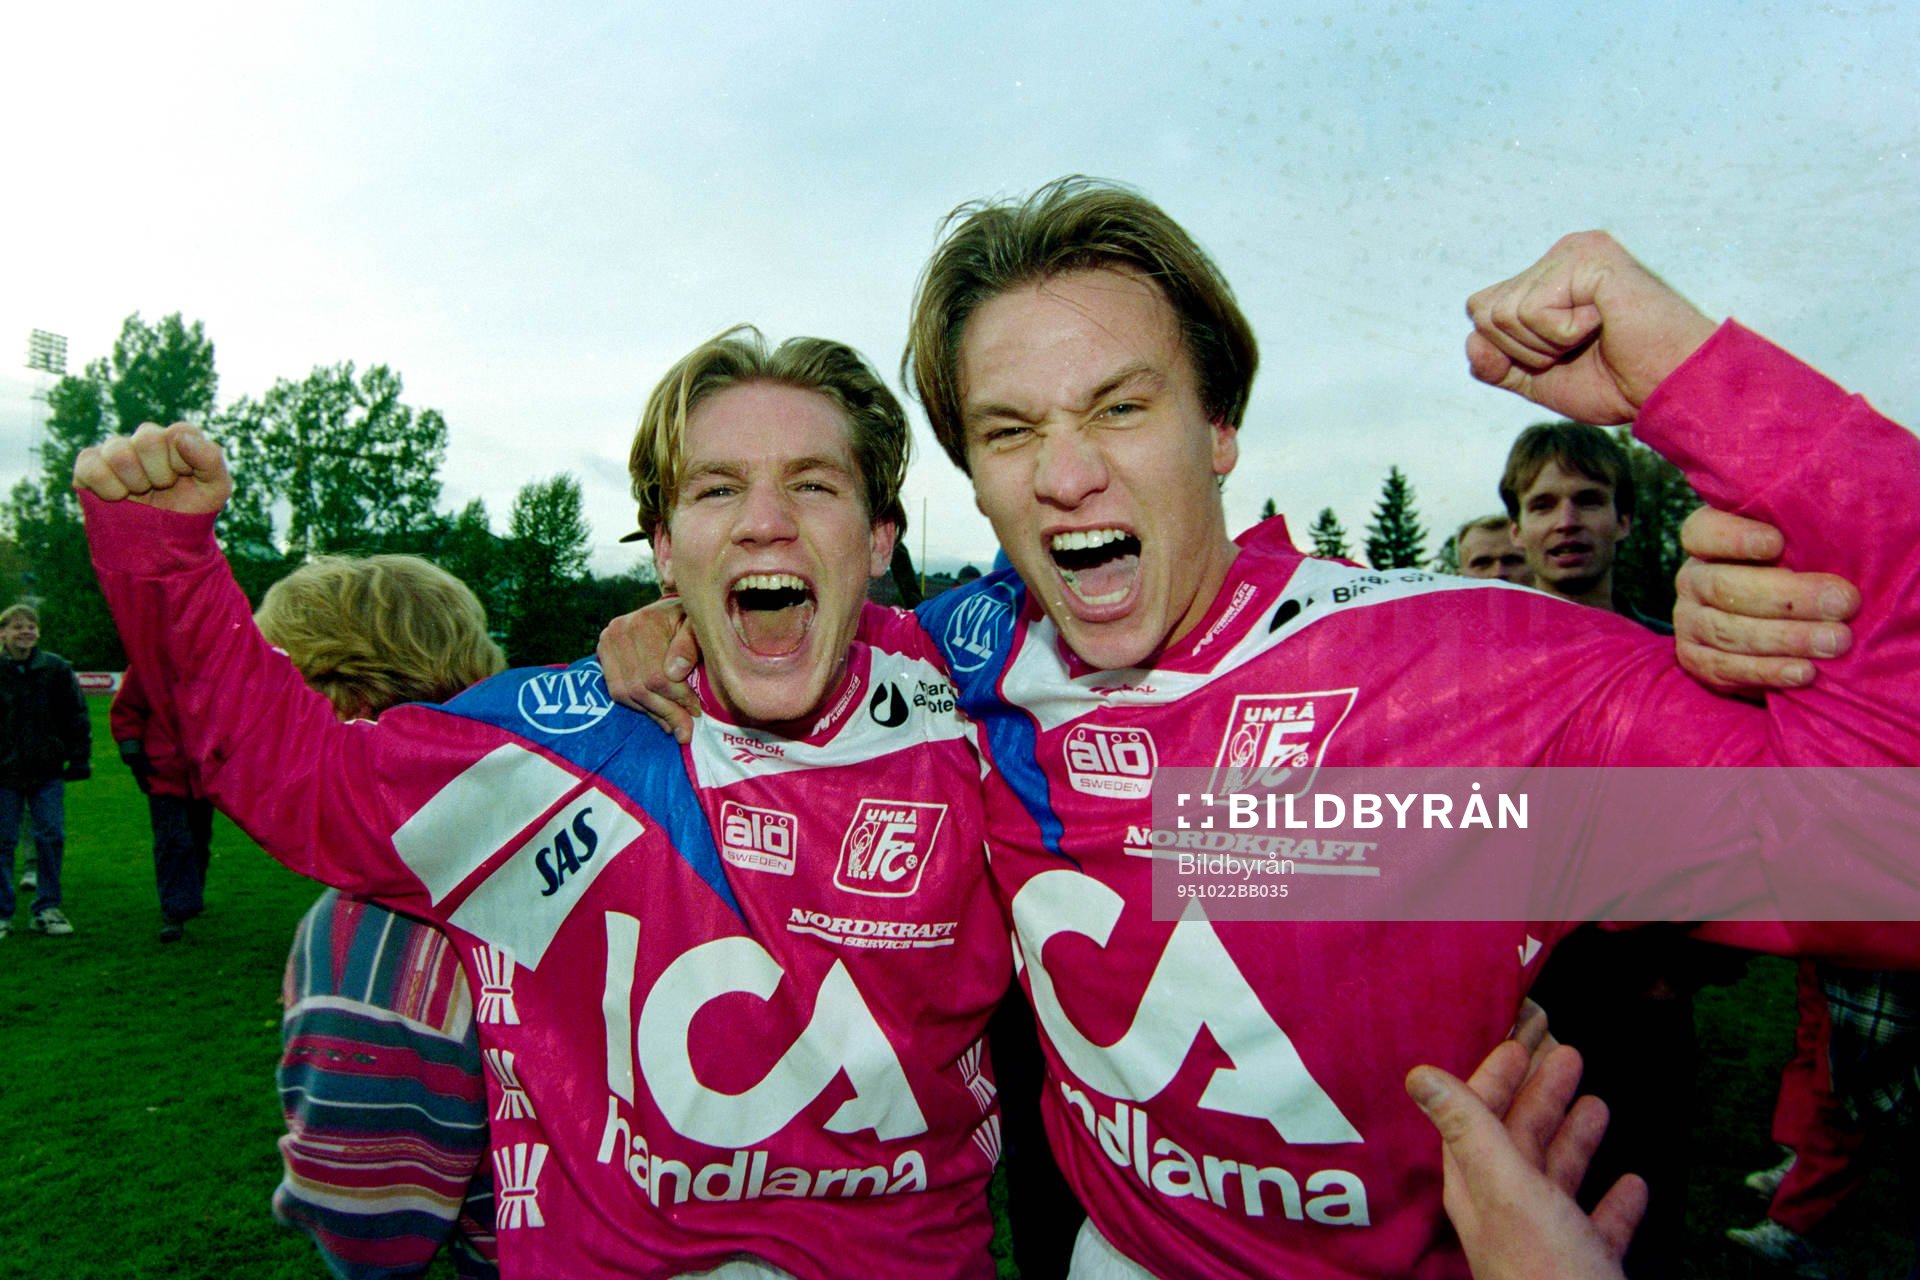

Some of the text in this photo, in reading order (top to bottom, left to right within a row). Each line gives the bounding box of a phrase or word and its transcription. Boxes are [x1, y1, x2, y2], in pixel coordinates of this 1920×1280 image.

[1244, 701, 1315, 722] UMEÅ
[723, 732, 785, 757] Reebok
[1079, 778, 1144, 793] SWEDEN
[535, 807, 598, 897] SAS
[1124, 826, 1379, 862] NORDKRAFT
[727, 850, 788, 871] SWEDEN
[788, 907, 958, 939] NORDKRAFT
[843, 937, 912, 950] SERVICE
[602, 910, 929, 1149] ICA
[597, 1095, 928, 1208] handlarna
